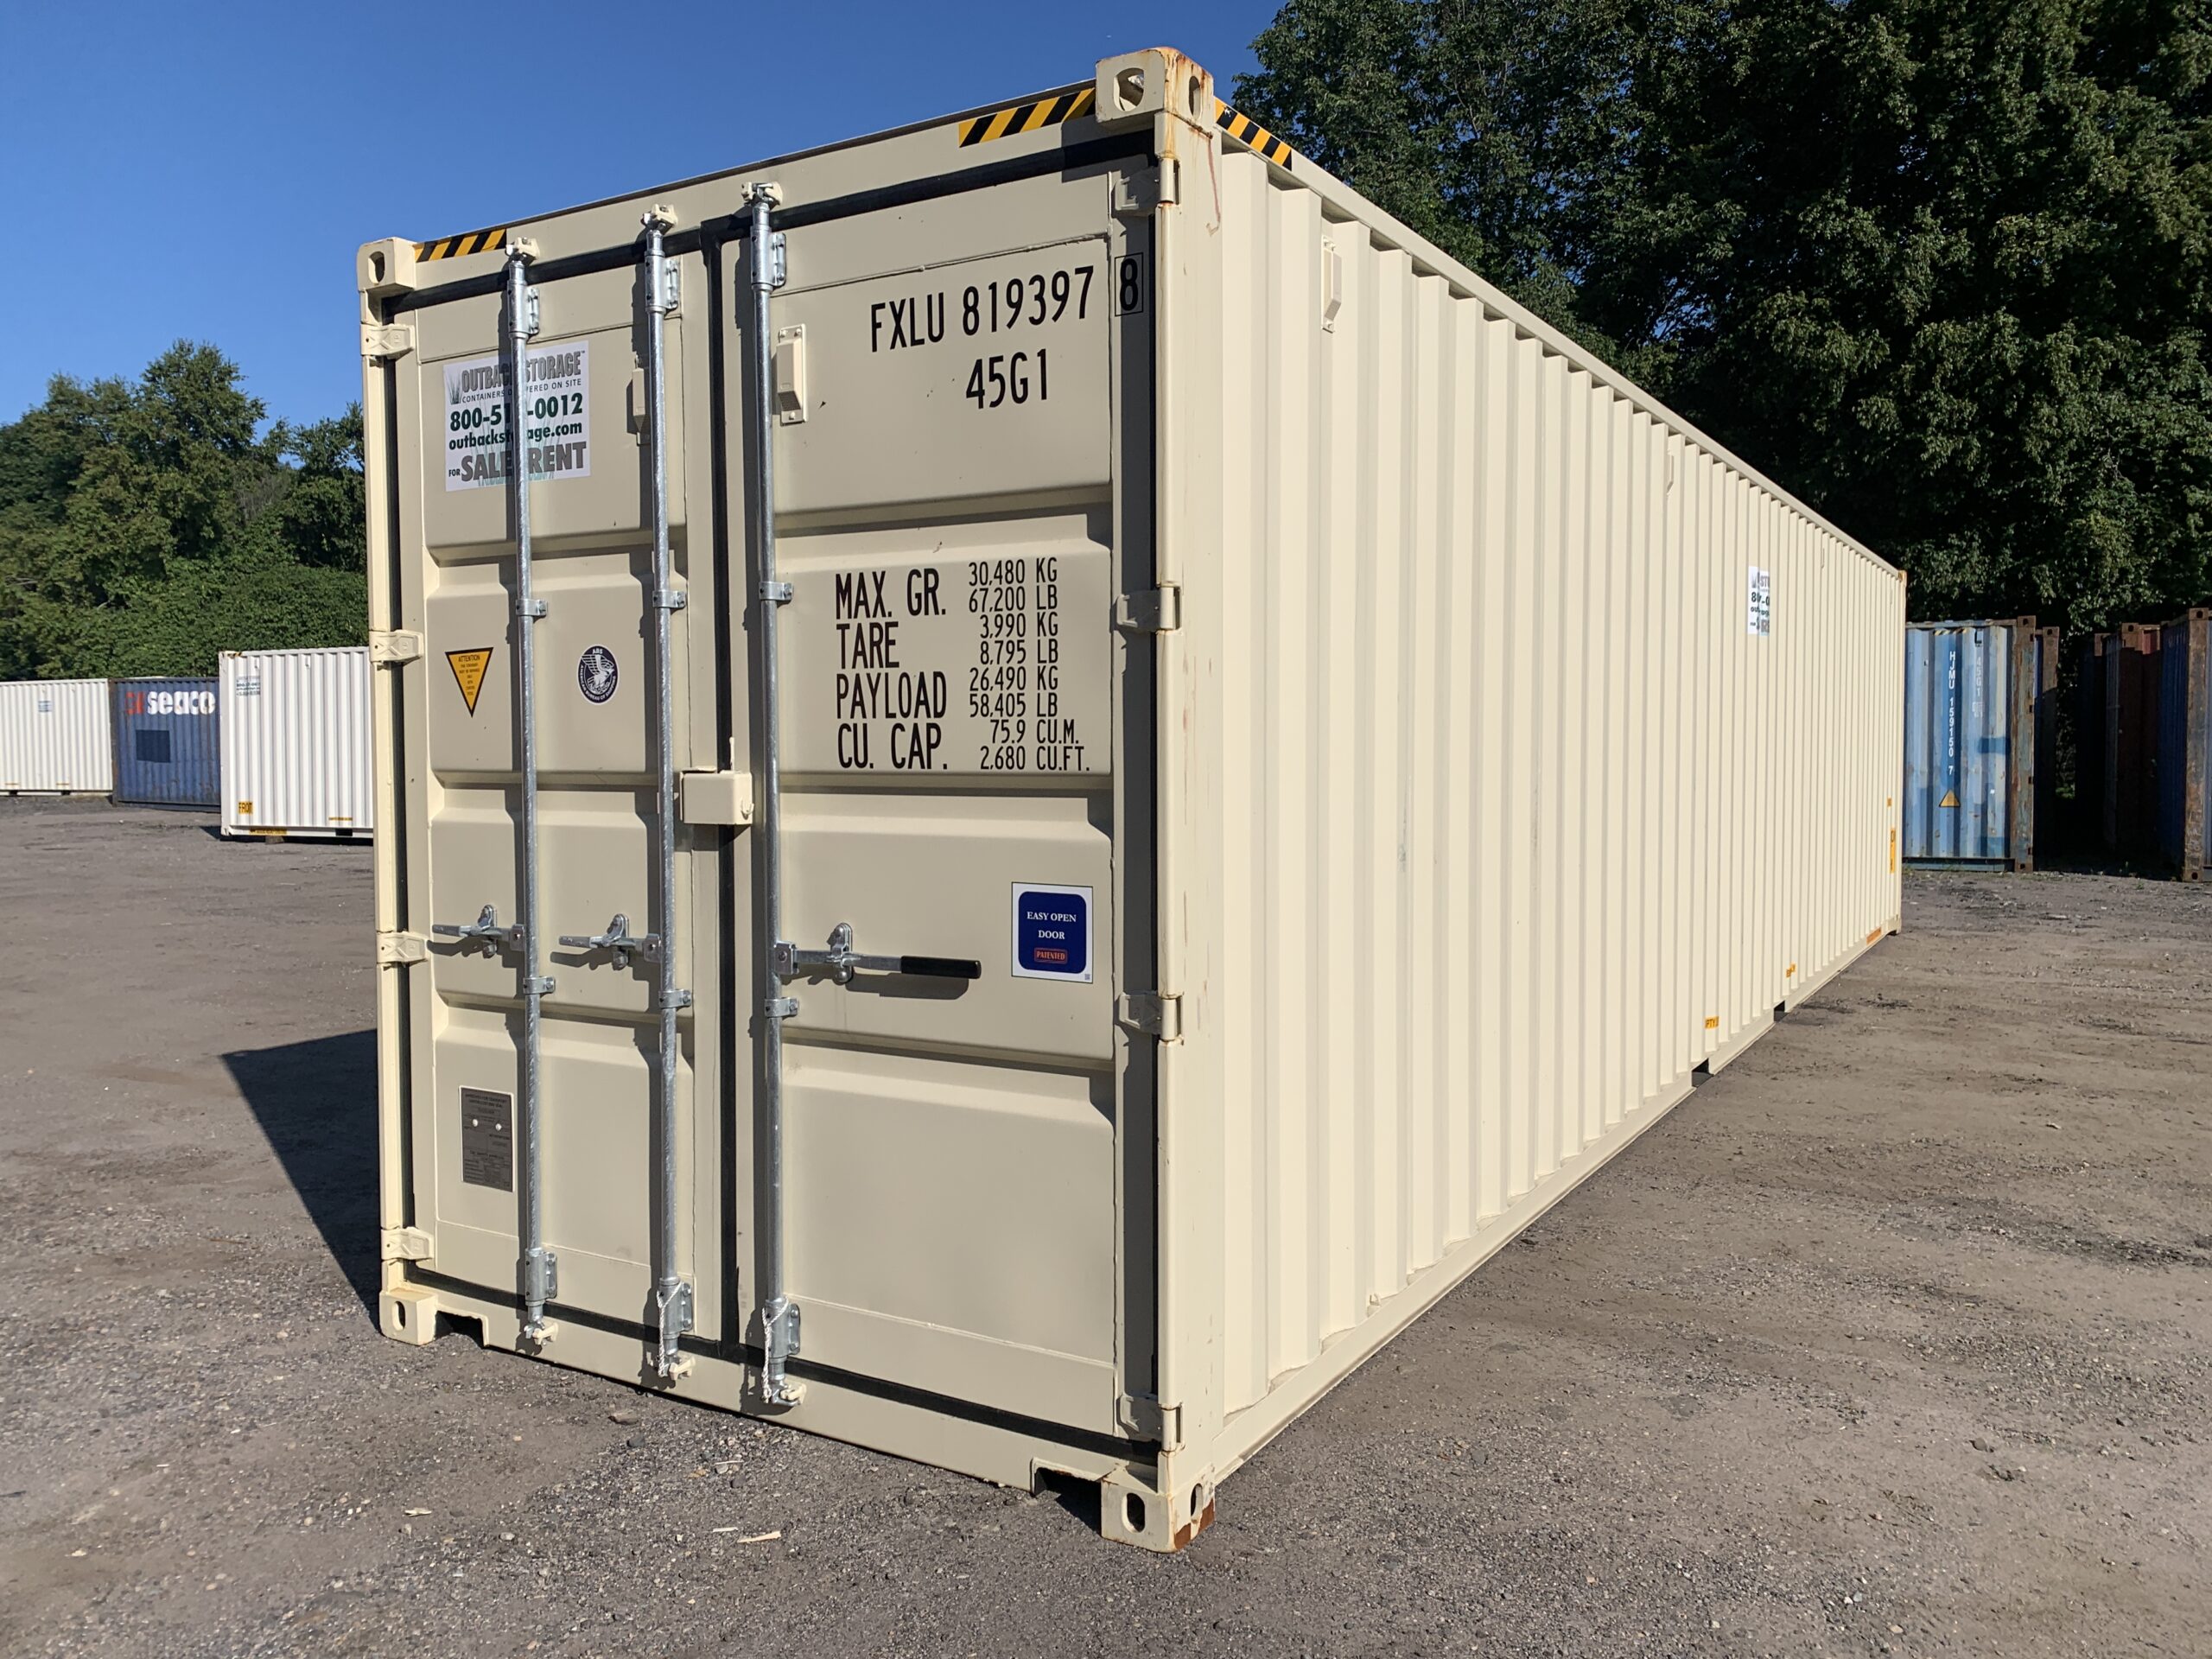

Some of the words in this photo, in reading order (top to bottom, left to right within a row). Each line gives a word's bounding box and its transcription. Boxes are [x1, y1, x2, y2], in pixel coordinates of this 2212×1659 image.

[871, 291, 944, 353] FXLU
[962, 264, 1094, 336] 819397
[1119, 257, 1139, 311] 8
[461, 362, 514, 393] OUTBAC
[461, 391, 505, 404] CONTAINERS
[551, 381, 563, 390] ON
[565, 378, 582, 388] SITE
[965, 347, 1047, 410] 45G1
[450, 392, 583, 431] 800-51-0012
[448, 468, 461, 477] FOR
[461, 450, 512, 482] SALE
[527, 441, 587, 474] RENT
[968, 558, 1026, 587] 30,480
[1035, 556, 1058, 583] KG
[835, 570, 893, 620] MAX.
[906, 567, 947, 616] GR.
[969, 586, 1026, 613] 67,200
[1036, 584, 1058, 610] LB
[979, 613, 1027, 639] 3,990
[1036, 611, 1058, 637] KG
[836, 620, 900, 670] TARE
[979, 639, 1027, 665] 8,795
[1036, 639, 1058, 664] LB
[969, 666, 1027, 692] 26,490
[1036, 665, 1058, 690] KG
[147, 690, 216, 715] seaco
[836, 671, 948, 720] PAYLOAD
[969, 692, 1027, 718] 58,405
[1036, 692, 1058, 717] LB
[989, 718, 1026, 744] 75.9
[1036, 718, 1079, 744] CU.M.
[837, 722, 874, 770] CU.
[890, 722, 948, 770] CAP.
[979, 745, 1026, 771] 2,680
[1036, 745, 1090, 772] CU.FT.
[1027, 912, 1049, 920] EASY
[1050, 912, 1077, 922] OPEN
[1038, 930, 1065, 939] DOOR
[1036, 951, 1065, 961] PATENTED
